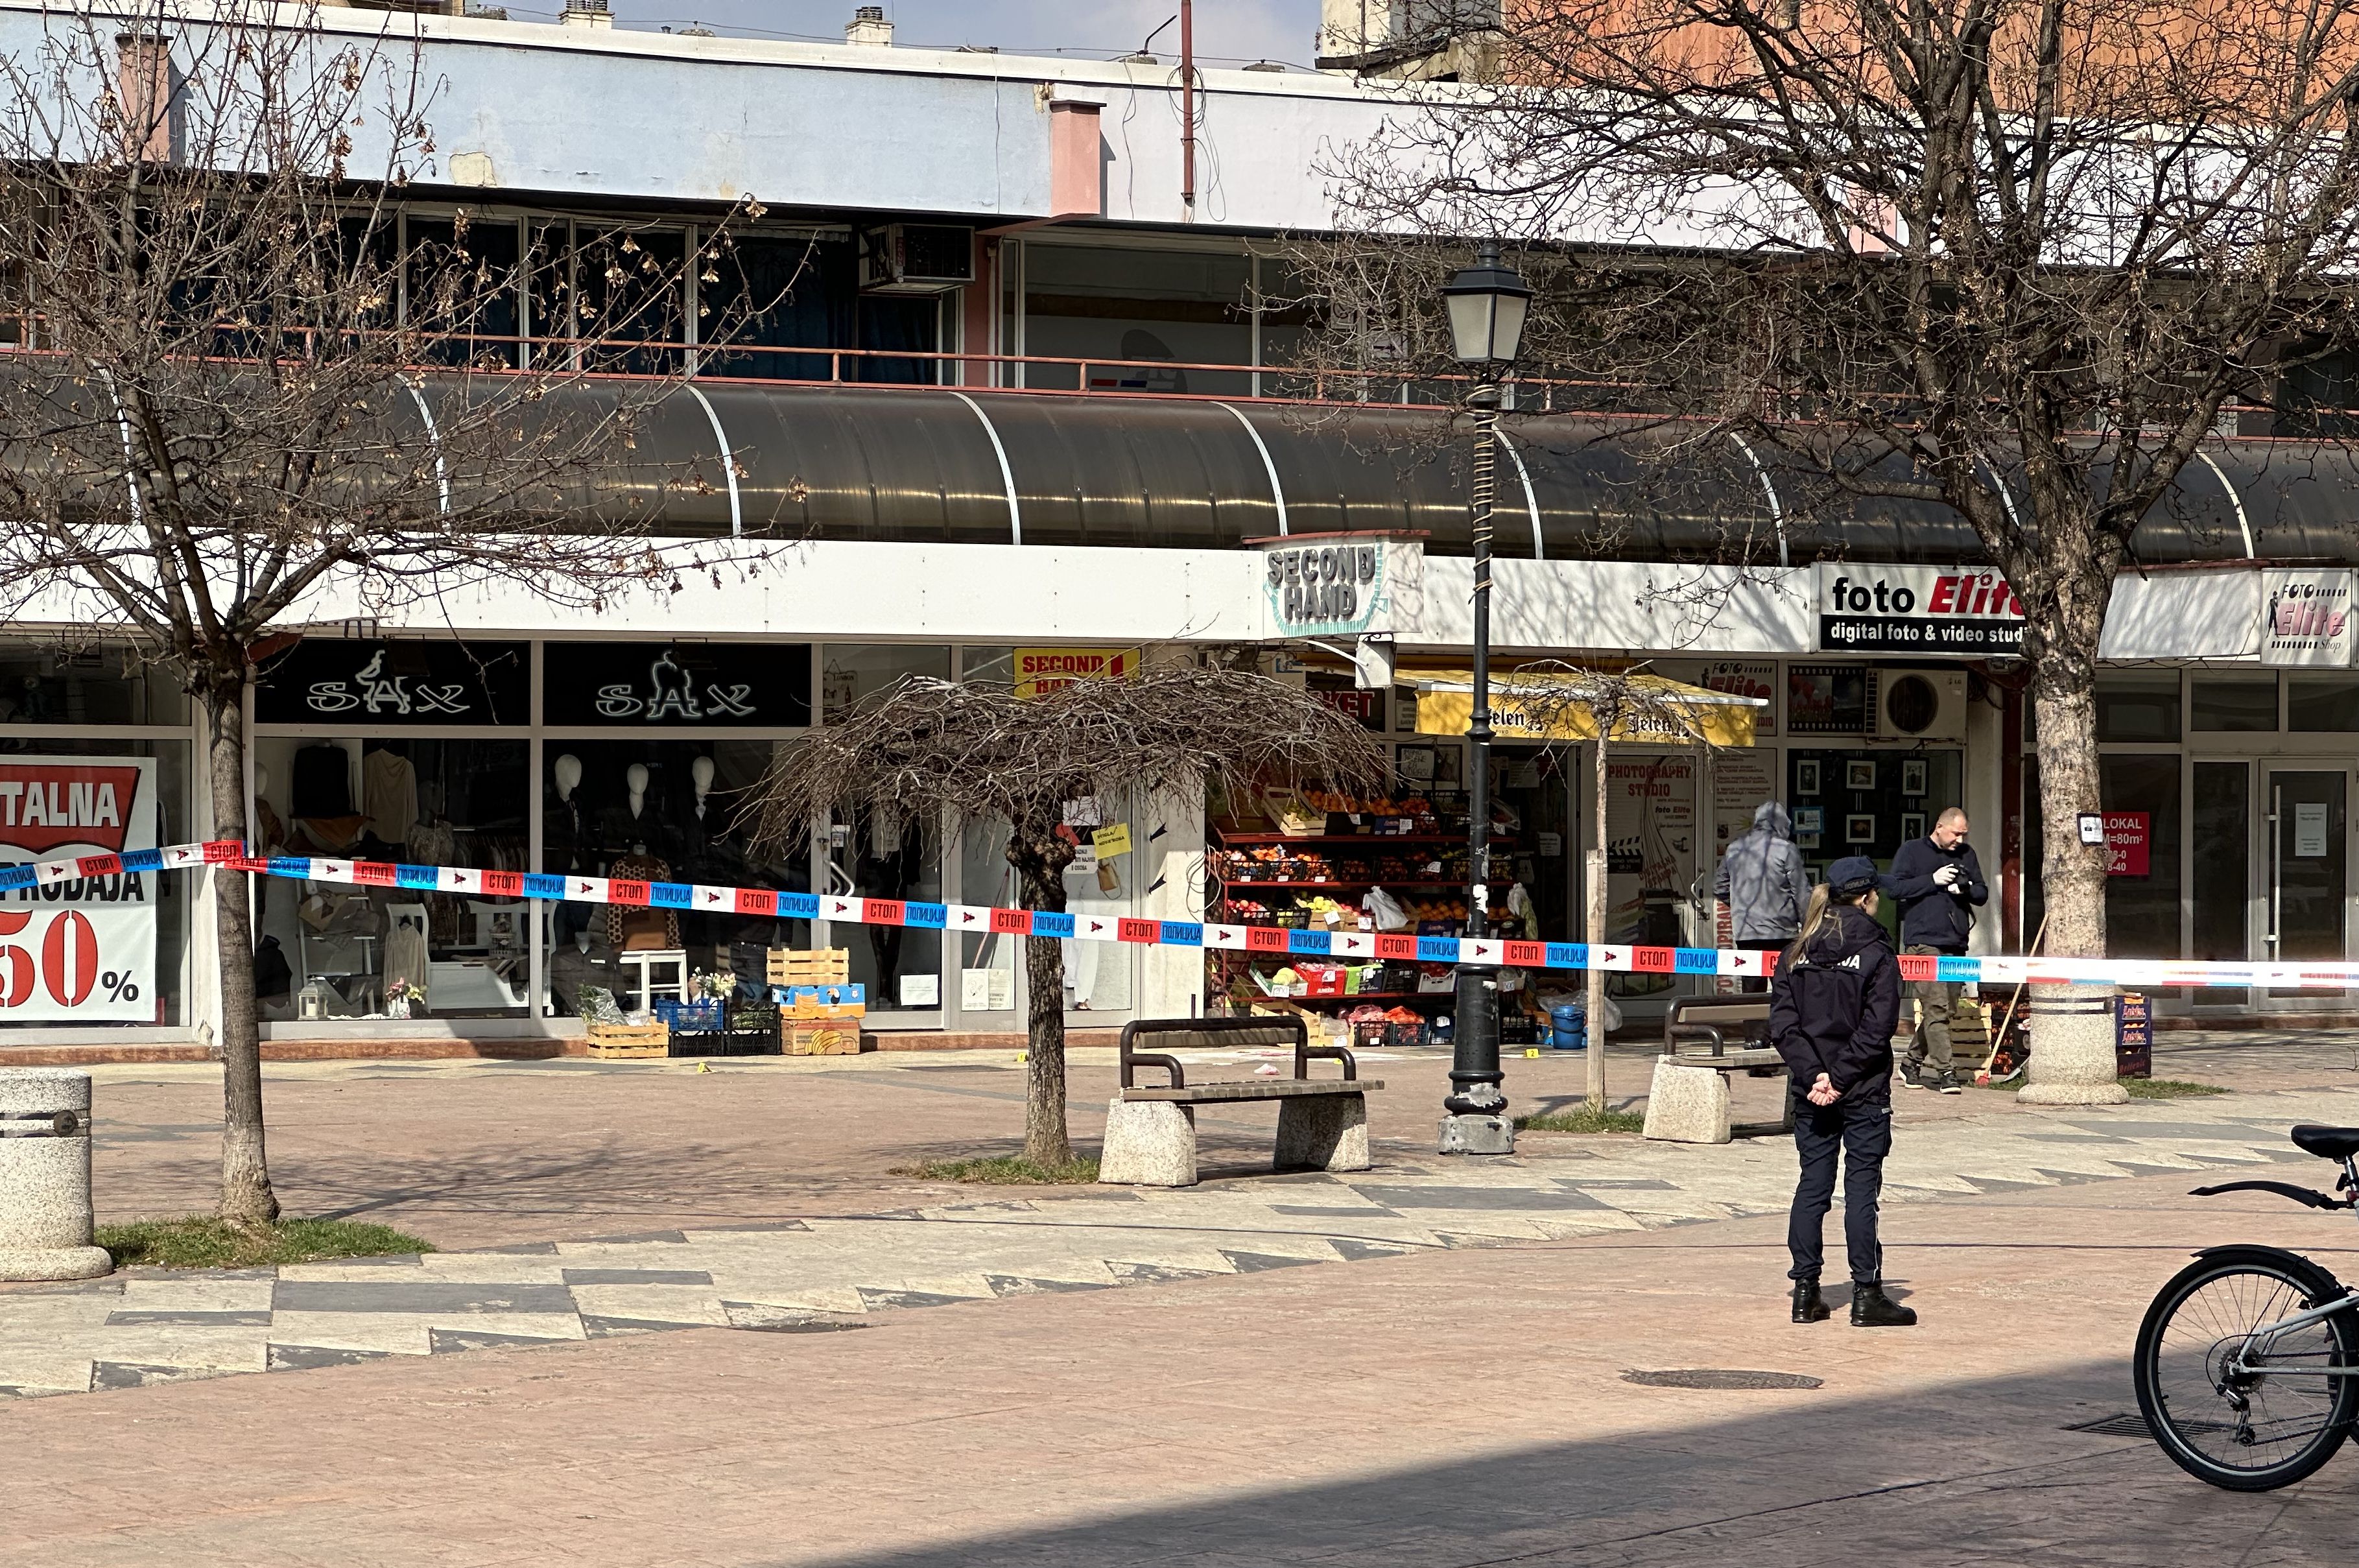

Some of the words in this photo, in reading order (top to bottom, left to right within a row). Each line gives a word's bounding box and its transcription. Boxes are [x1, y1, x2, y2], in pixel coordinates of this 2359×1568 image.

[1268, 547, 1375, 584] SECOND
[1832, 576, 1915, 613] foto
[2281, 584, 2314, 599] FOTO
[1285, 583, 1357, 621] HAND
[2275, 600, 2345, 637] Elite
[1831, 622, 1882, 643] digital
[1887, 624, 1919, 641] foto
[1925, 624, 1936, 641] &
[1941, 625, 1984, 643] video
[2319, 639, 2341, 653] Shop
[1023, 656, 1104, 673] SECOND
[1713, 663, 1743, 674] FOTO
[1488, 706, 1525, 726] elen
[1607, 765, 1692, 779] PHOTOGRAPHY
[1628, 783, 1671, 797] STUDIO
[0, 781, 121, 827] TALNA
[2103, 818, 2142, 829] LOKAL
[85, 857, 115, 872] СТОП
[121, 852, 162, 867] ПОЛИЦИЈА
[210, 844, 237, 859] СТОП
[361, 865, 389, 879] СТОП
[397, 866, 438, 884] ПОЛИЦИЈА
[489, 875, 516, 890] СТОП
[525, 877, 565, 894] ПОЛИЦИЈА
[617, 885, 643, 899] СТОП
[652, 887, 692, 903] ПОЛИЦИЈА
[744, 894, 770, 909] СТОП
[779, 896, 819, 913] ПОЛИЦИЈА
[870, 904, 898, 919] СТОП
[907, 907, 946, 923] ПОЛИЦИЈА
[998, 914, 1025, 929] СТОП
[1034, 916, 1074, 932] ПОЛИЦИЈА
[1125, 922, 1154, 937] СТОП
[1163, 925, 1202, 942] ПОЛИЦИЈА
[1254, 931, 1281, 945] СТОП
[1291, 934, 1330, 950] ПОЛИЦИЈА
[1382, 938, 1410, 953] СТОП
[1419, 941, 1458, 957] ПОЛИЦИЈА
[1511, 945, 1539, 960] СТОП
[1548, 947, 1587, 964] ПОЛИЦИЈА
[1639, 951, 1668, 967] СТОП
[1677, 953, 1717, 969] ПОЛИЦИЈА
[1901, 960, 1929, 975] СТОП
